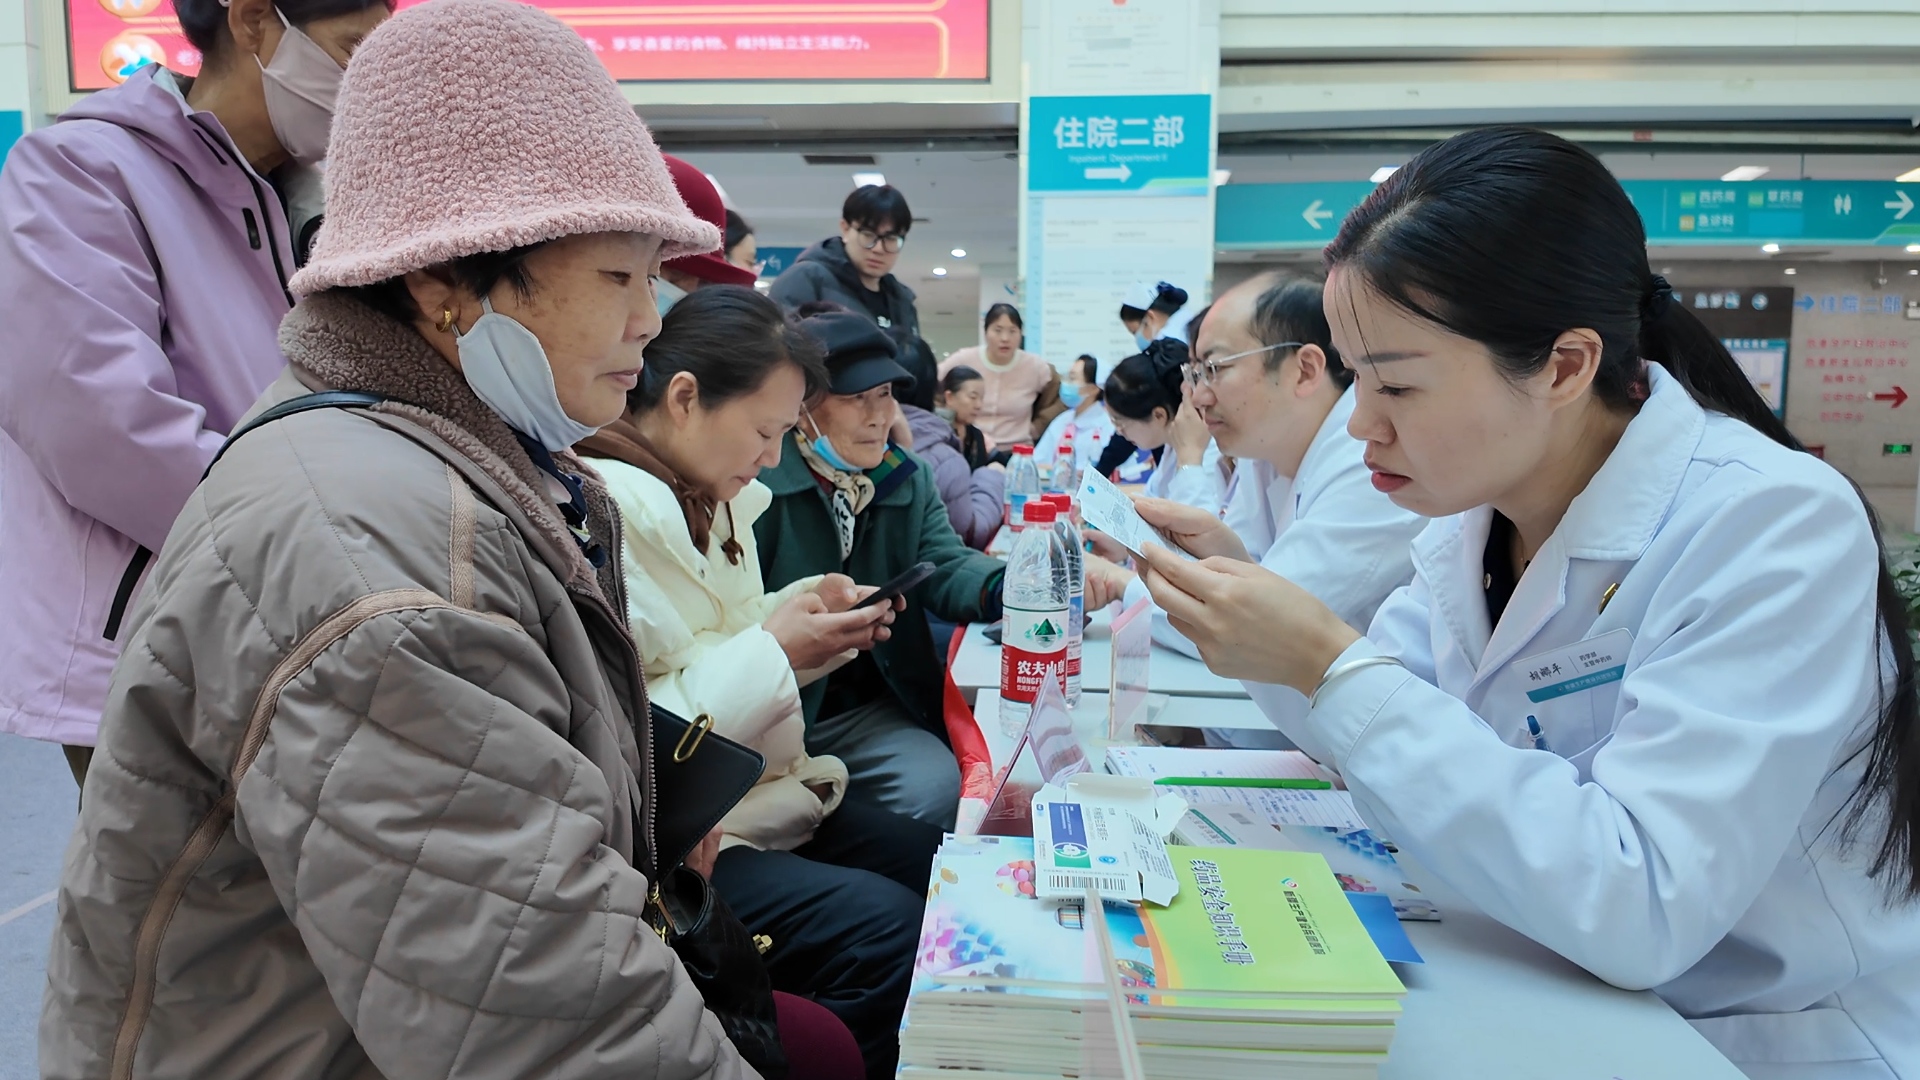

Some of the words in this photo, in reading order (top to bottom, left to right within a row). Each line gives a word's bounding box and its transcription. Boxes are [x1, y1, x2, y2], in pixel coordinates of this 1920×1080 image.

[1053, 115, 1185, 149] 住院二部
[1700, 190, 1736, 203] 西药房
[1698, 213, 1734, 227] 急诊科
[1820, 295, 1902, 313] 住院二部
[1189, 859, 1255, 966] 药品安全知识手册
